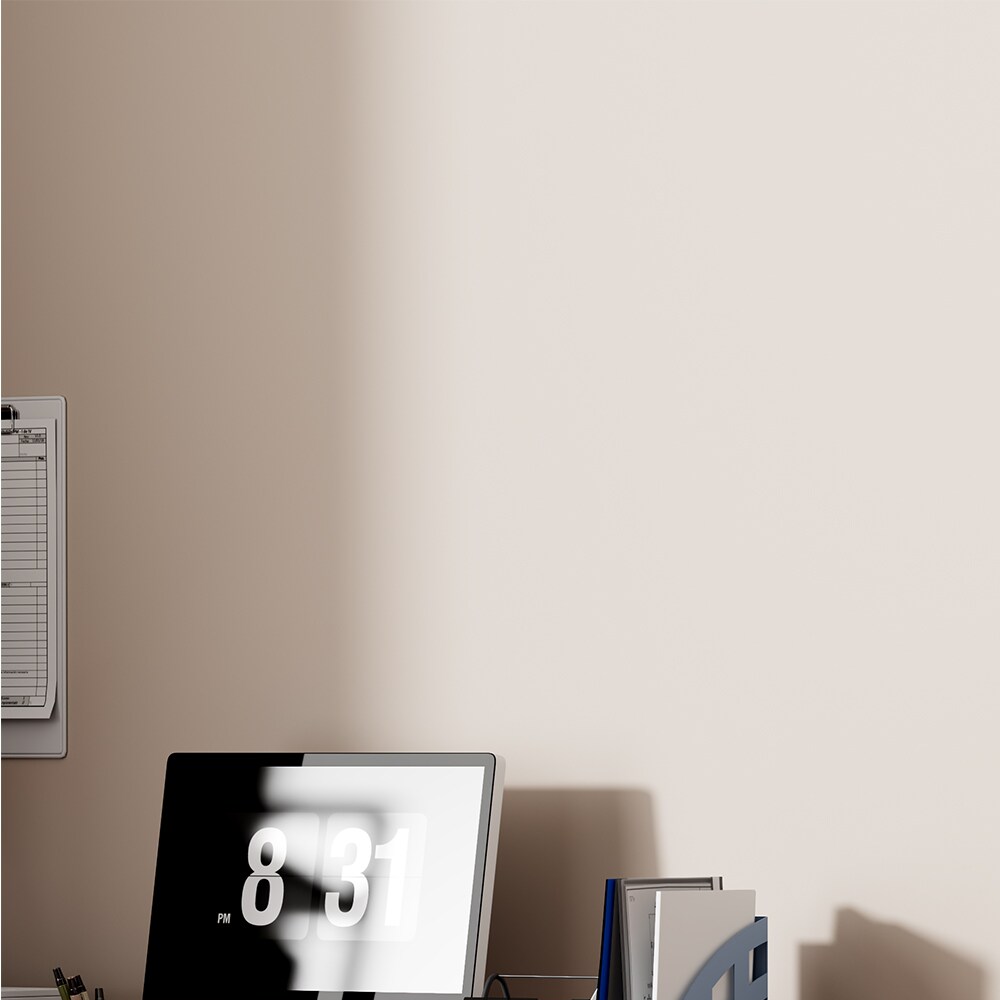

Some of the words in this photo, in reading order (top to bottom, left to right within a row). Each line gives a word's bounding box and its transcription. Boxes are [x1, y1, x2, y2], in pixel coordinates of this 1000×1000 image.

[241, 827, 287, 926] 8
[324, 827, 410, 927] 31
[217, 913, 231, 924] PM
